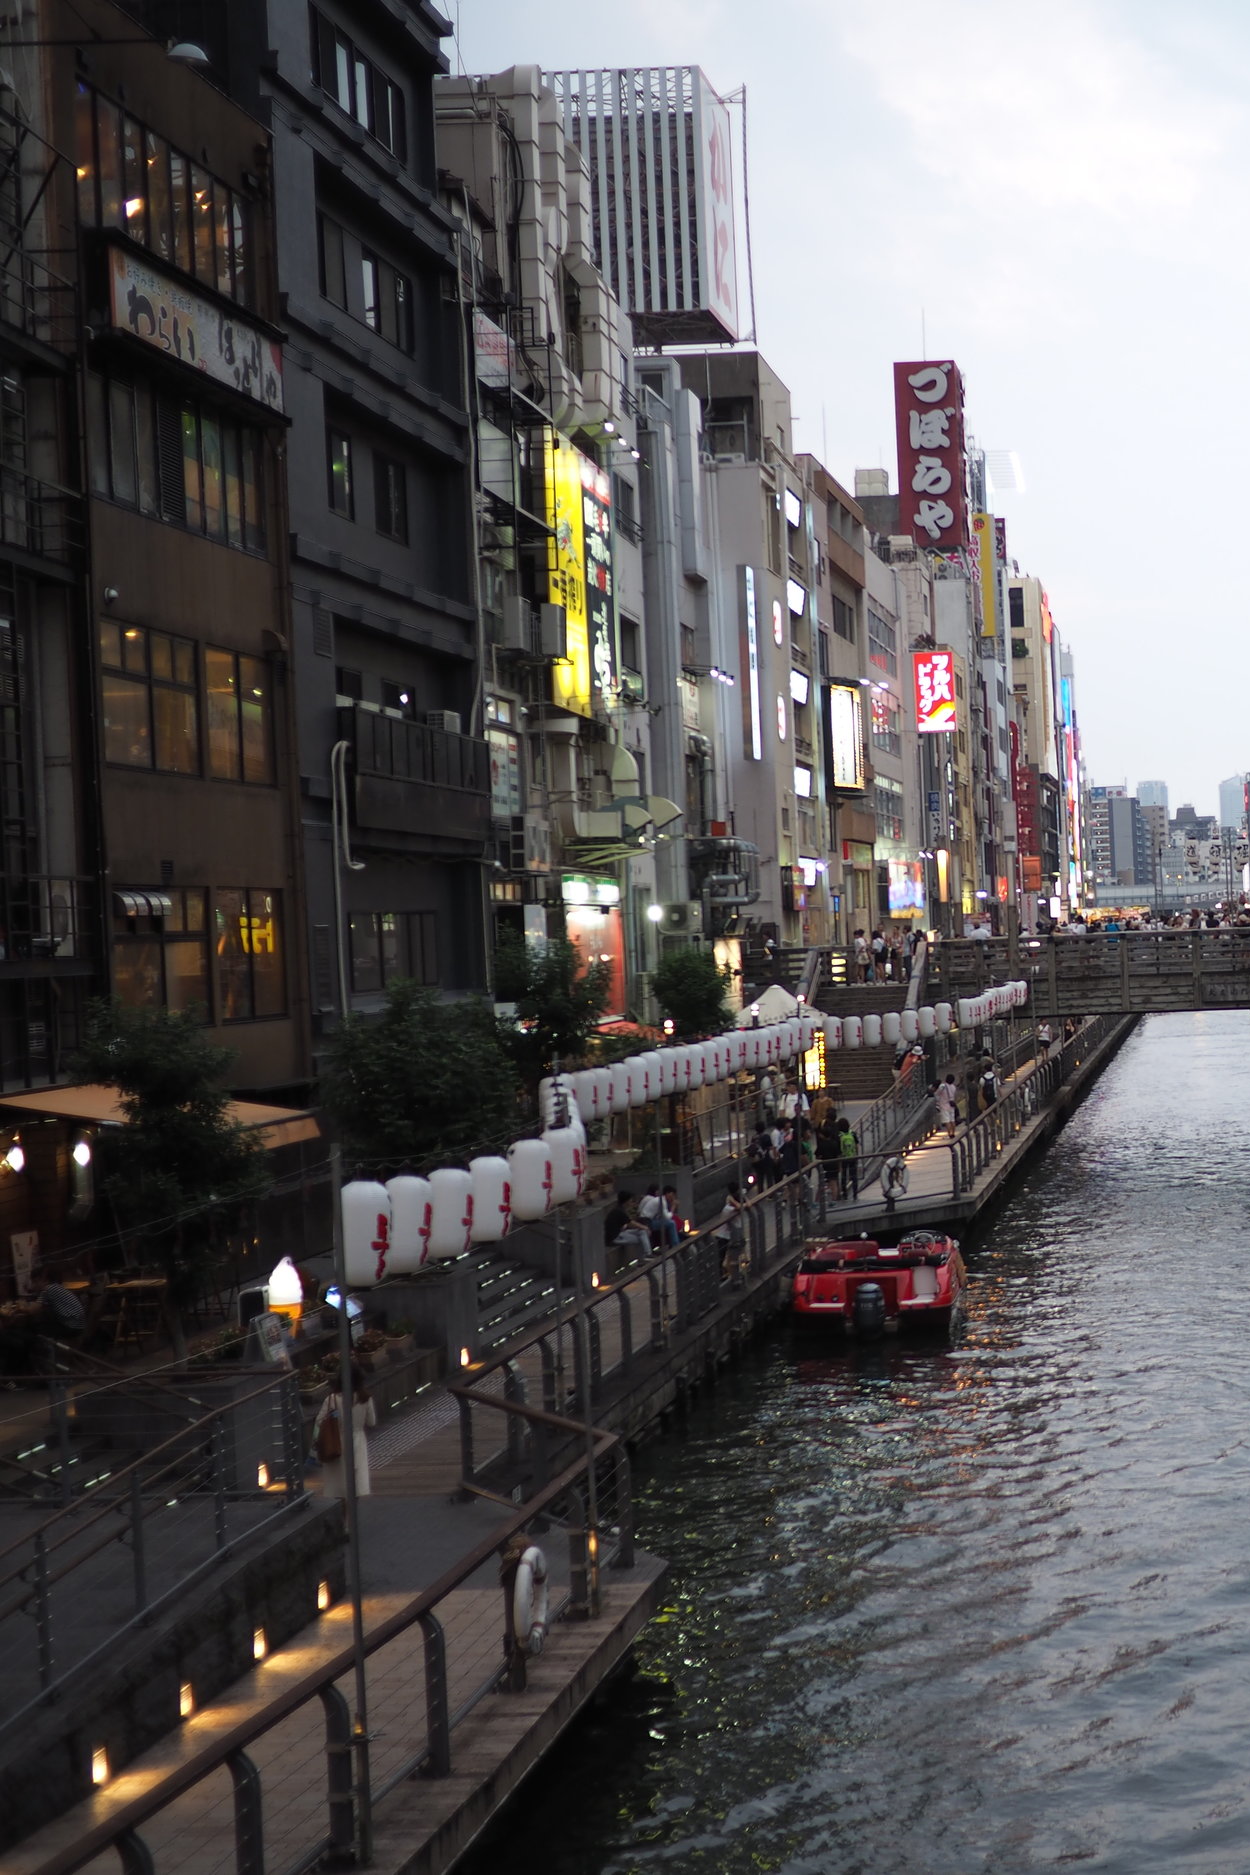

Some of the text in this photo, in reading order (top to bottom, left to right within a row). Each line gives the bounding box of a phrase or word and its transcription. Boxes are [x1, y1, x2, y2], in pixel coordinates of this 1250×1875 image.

[126, 282, 196, 362] わらい
[908, 362, 955, 540] づぼらや
